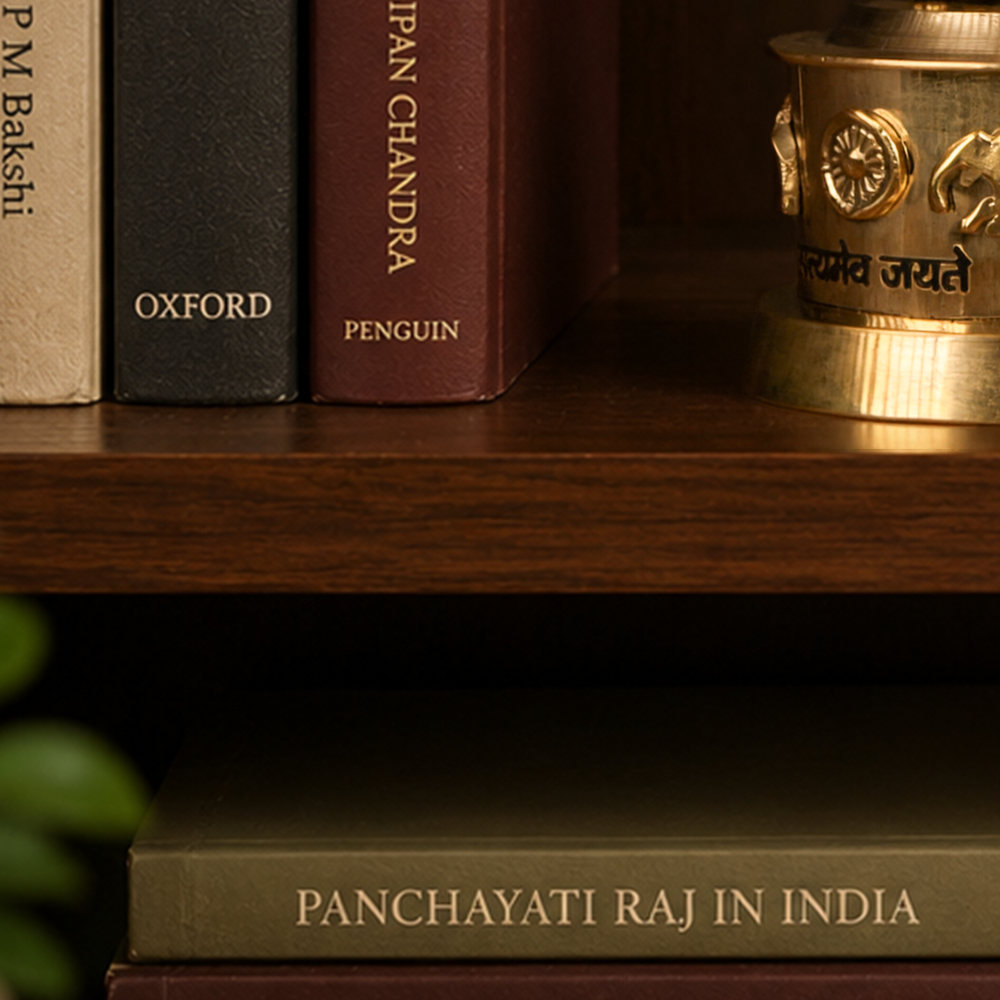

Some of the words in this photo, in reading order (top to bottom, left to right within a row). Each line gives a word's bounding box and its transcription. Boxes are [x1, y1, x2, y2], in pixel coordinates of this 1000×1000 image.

[2, 5, 33, 30] P
[1, 40, 33, 79] M
[1, 93, 35, 219] Bakshi
[388, 94, 417, 274] CHANDRA
[878, 244, 972, 293] जयते
[136, 292, 272, 319] OXFORD
[344, 321, 460, 341] PENGUIN
[297, 889, 596, 926] PANCHAYATI
[615, 889, 695, 933] RAJ
[714, 889, 763, 925] IN
[782, 888, 920, 925] INDIA
